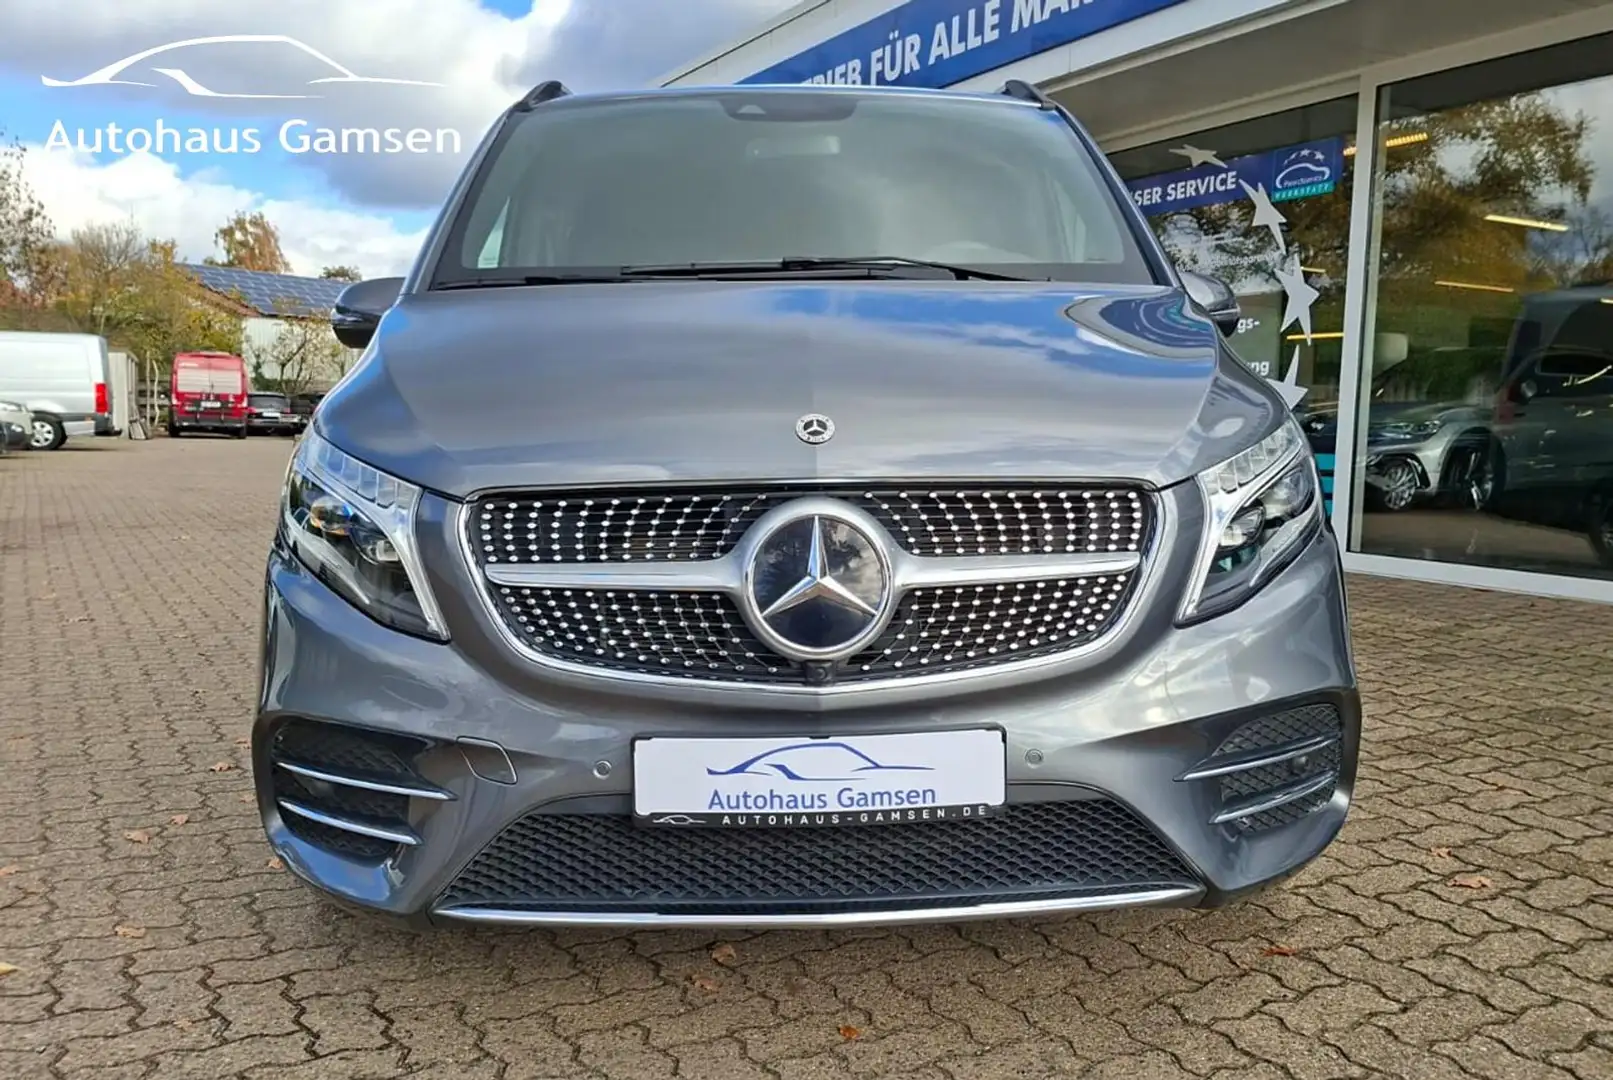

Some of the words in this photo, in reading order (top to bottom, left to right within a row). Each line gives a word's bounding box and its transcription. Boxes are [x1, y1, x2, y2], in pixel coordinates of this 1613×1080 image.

[870, 30, 921, 86] FÜR
[927, 0, 1000, 66] ALLE
[1130, 186, 1162, 207] SER
[1166, 170, 1237, 202] SERVICE
[1247, 361, 1269, 376] ng
[707, 788, 828, 811] Autohaus
[837, 786, 936, 808] Gamsen
[722, 805, 988, 825] AUTOHAUS-GAMSEN.DE
